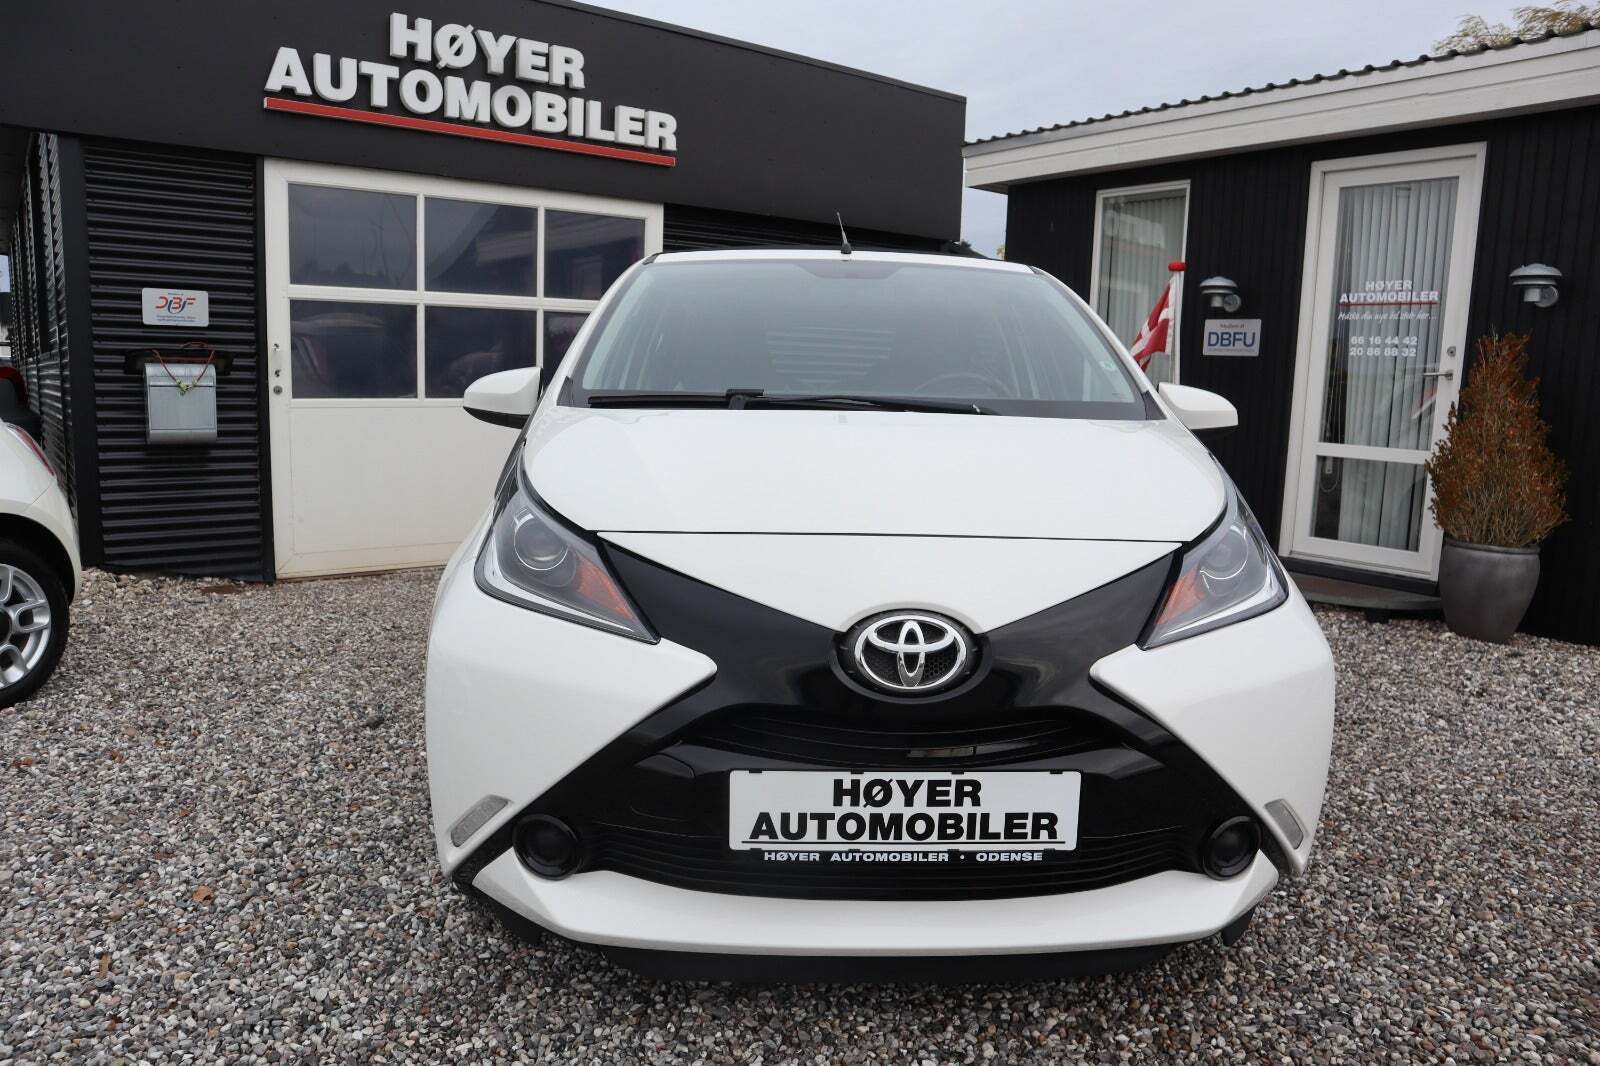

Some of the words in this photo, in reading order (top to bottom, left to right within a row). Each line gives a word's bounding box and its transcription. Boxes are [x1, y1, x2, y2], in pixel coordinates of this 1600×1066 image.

[389, 12, 586, 89] HØYER
[263, 46, 678, 152] AUTOMOBILER
[1365, 280, 1413, 292] HØYER
[1339, 291, 1440, 303] AUTOMOBILER
[1207, 331, 1256, 348] DBFU
[1384, 335, 1399, 345] 44
[1402, 335, 1418, 345] 42
[1349, 347, 1364, 356] 20
[832, 778, 982, 808] HØYER
[749, 812, 1059, 841] AUTOMOBILER
[763, 851, 820, 862] HØYER
[829, 852, 949, 863] AUTOMOBILER
[975, 852, 1044, 863] ODENSE
